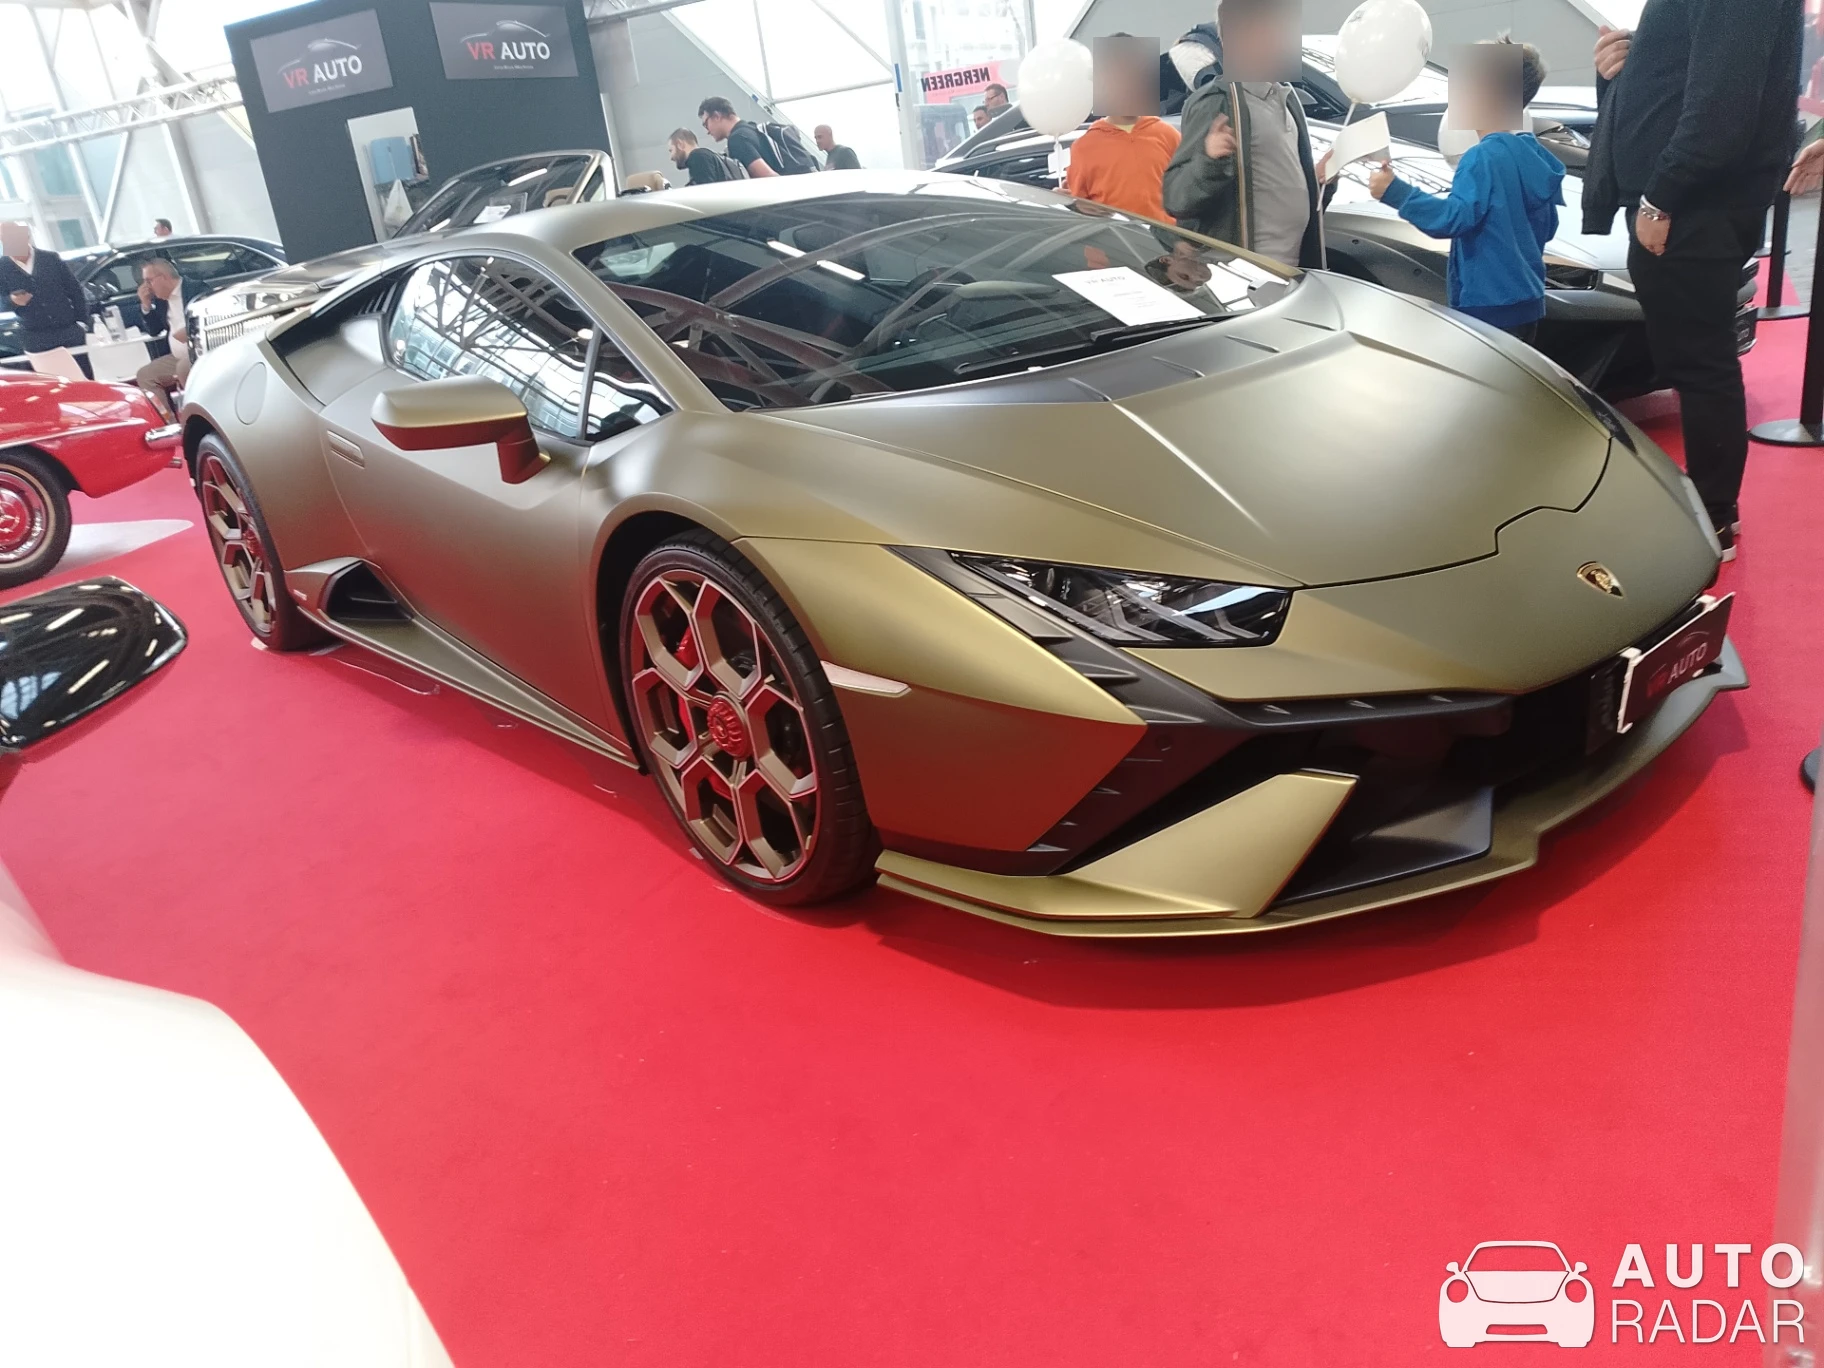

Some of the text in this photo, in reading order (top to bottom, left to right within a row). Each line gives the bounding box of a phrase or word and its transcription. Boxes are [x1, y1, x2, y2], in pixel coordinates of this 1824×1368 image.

[467, 41, 550, 60] VR AUTO
[283, 55, 362, 88] VR AUTO
[1667, 642, 1707, 684] AUTO
